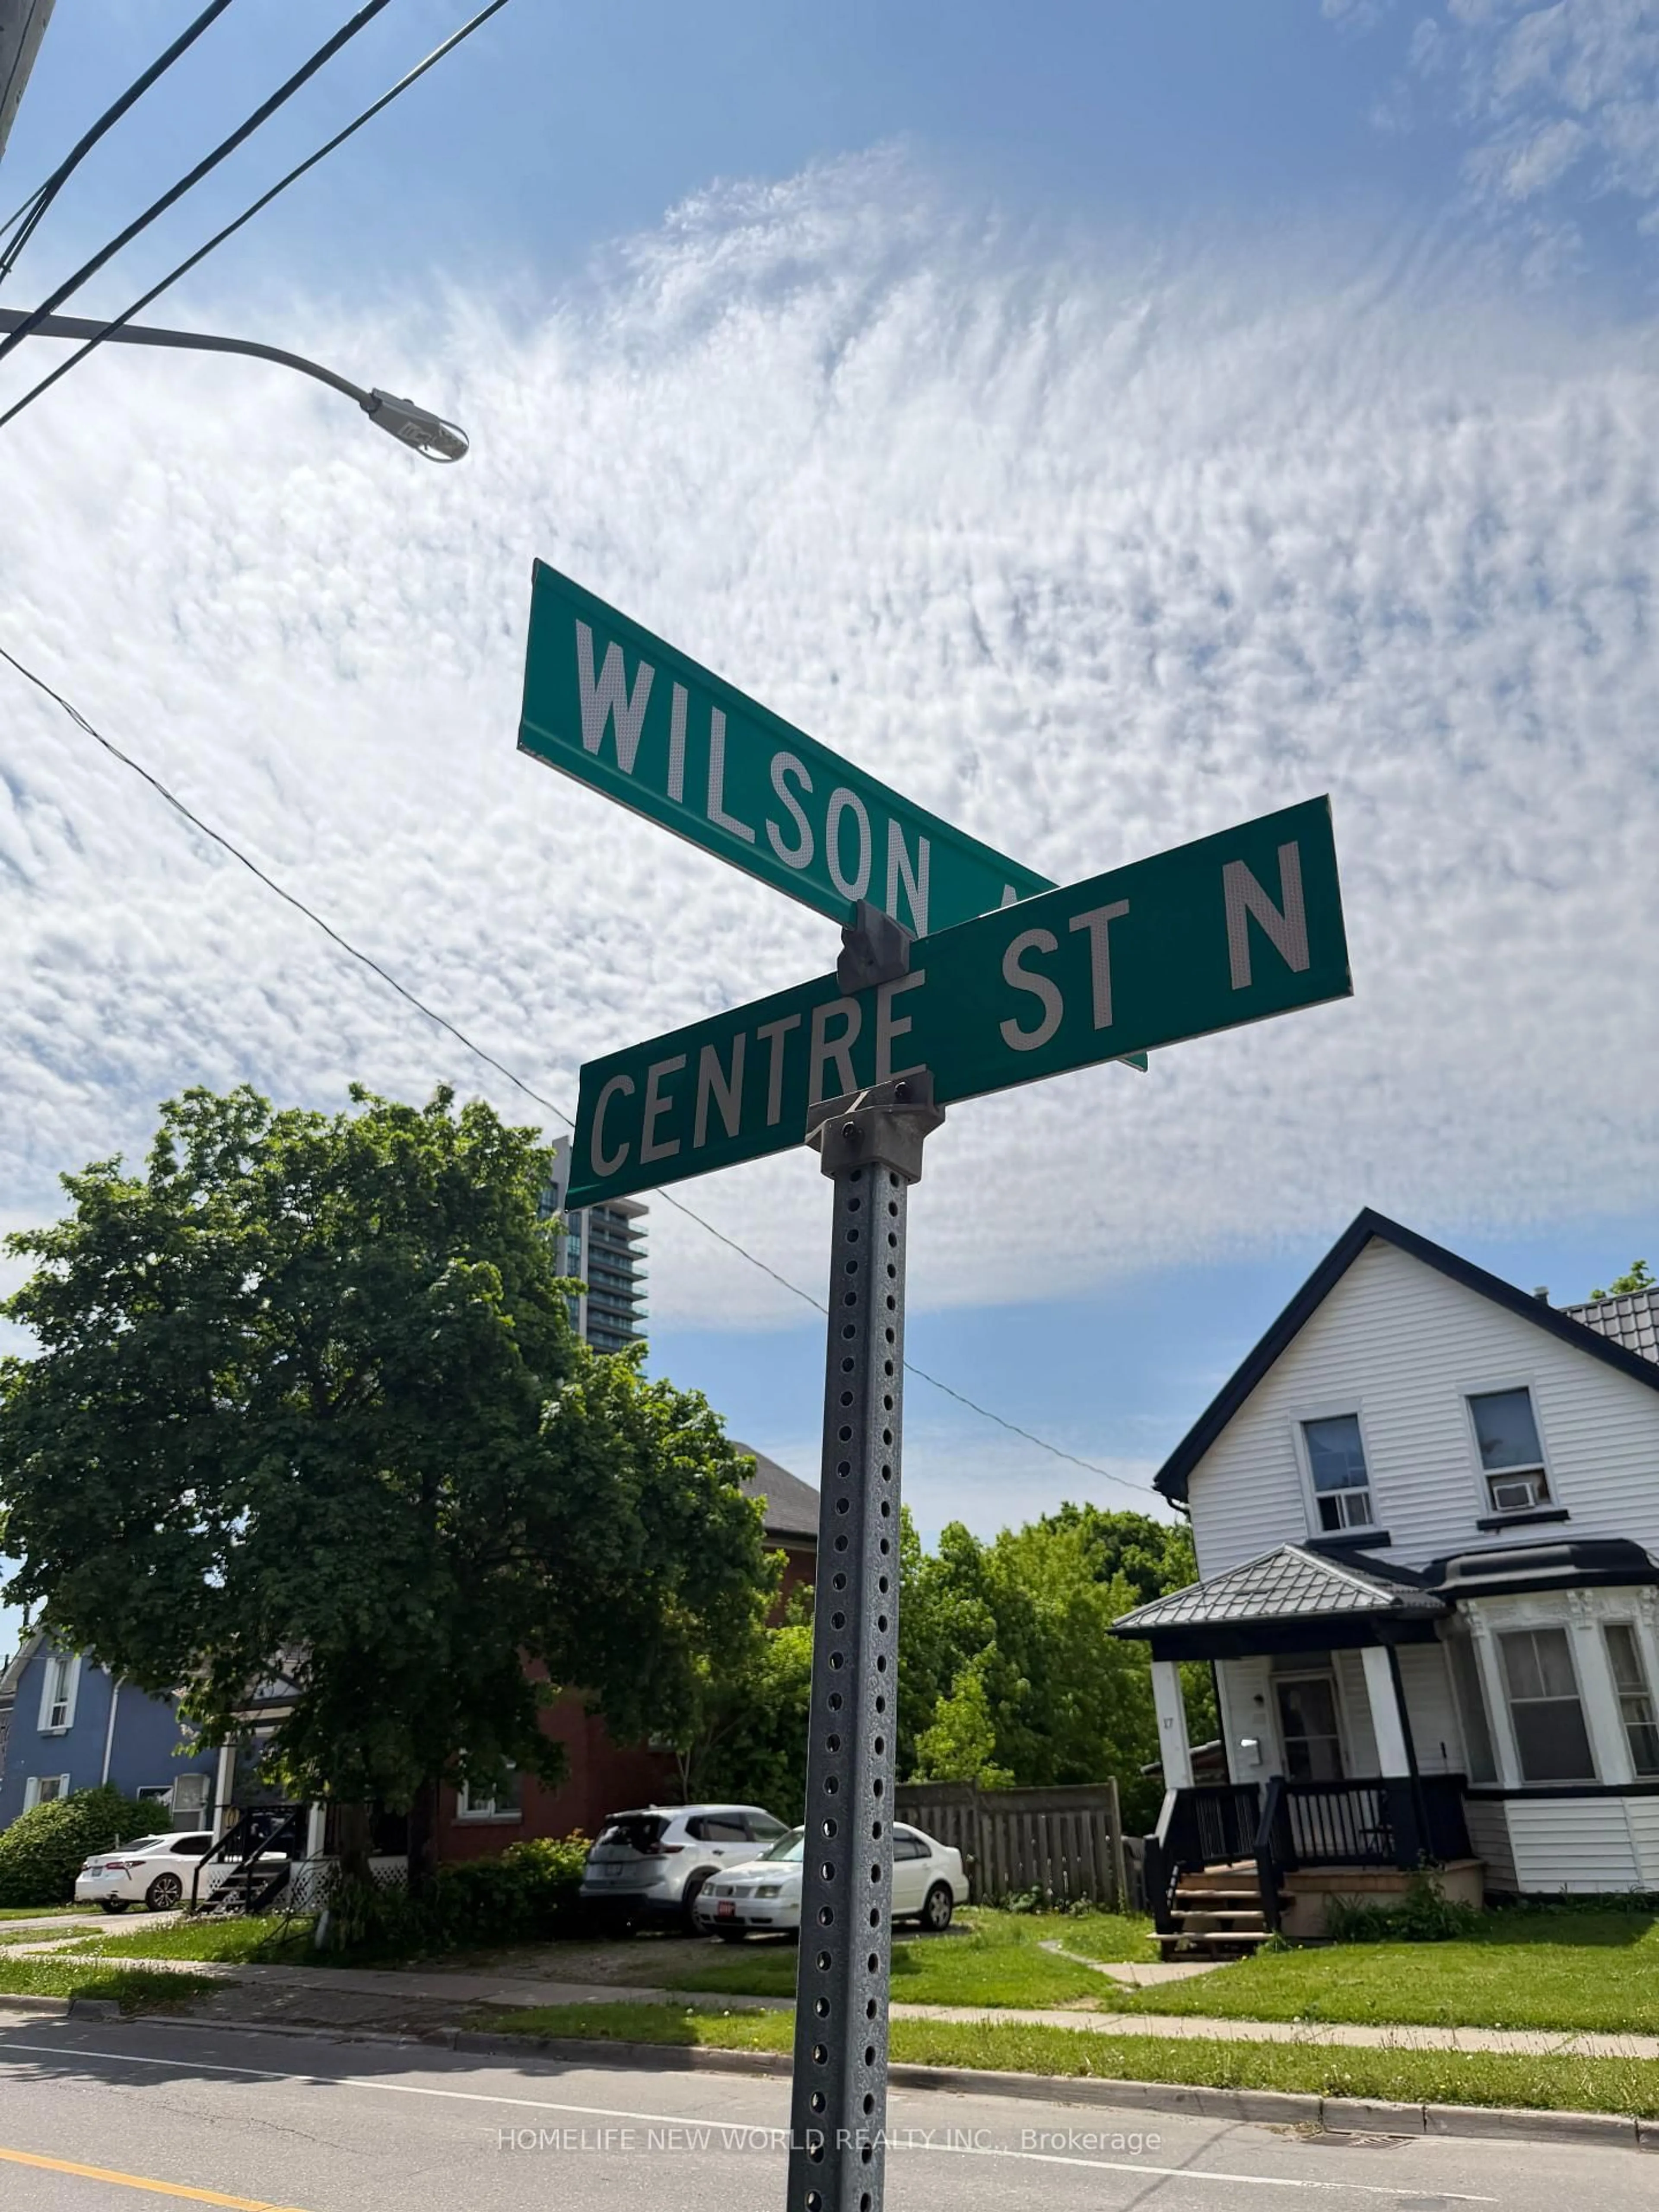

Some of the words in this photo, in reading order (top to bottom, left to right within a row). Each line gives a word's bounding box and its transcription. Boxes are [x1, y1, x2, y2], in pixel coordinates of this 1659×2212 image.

[575, 618, 930, 939] WILSON
[591, 969, 926, 1177] CENTRE
[999, 899, 1130, 1052] ST
[1222, 840, 1309, 990] N
